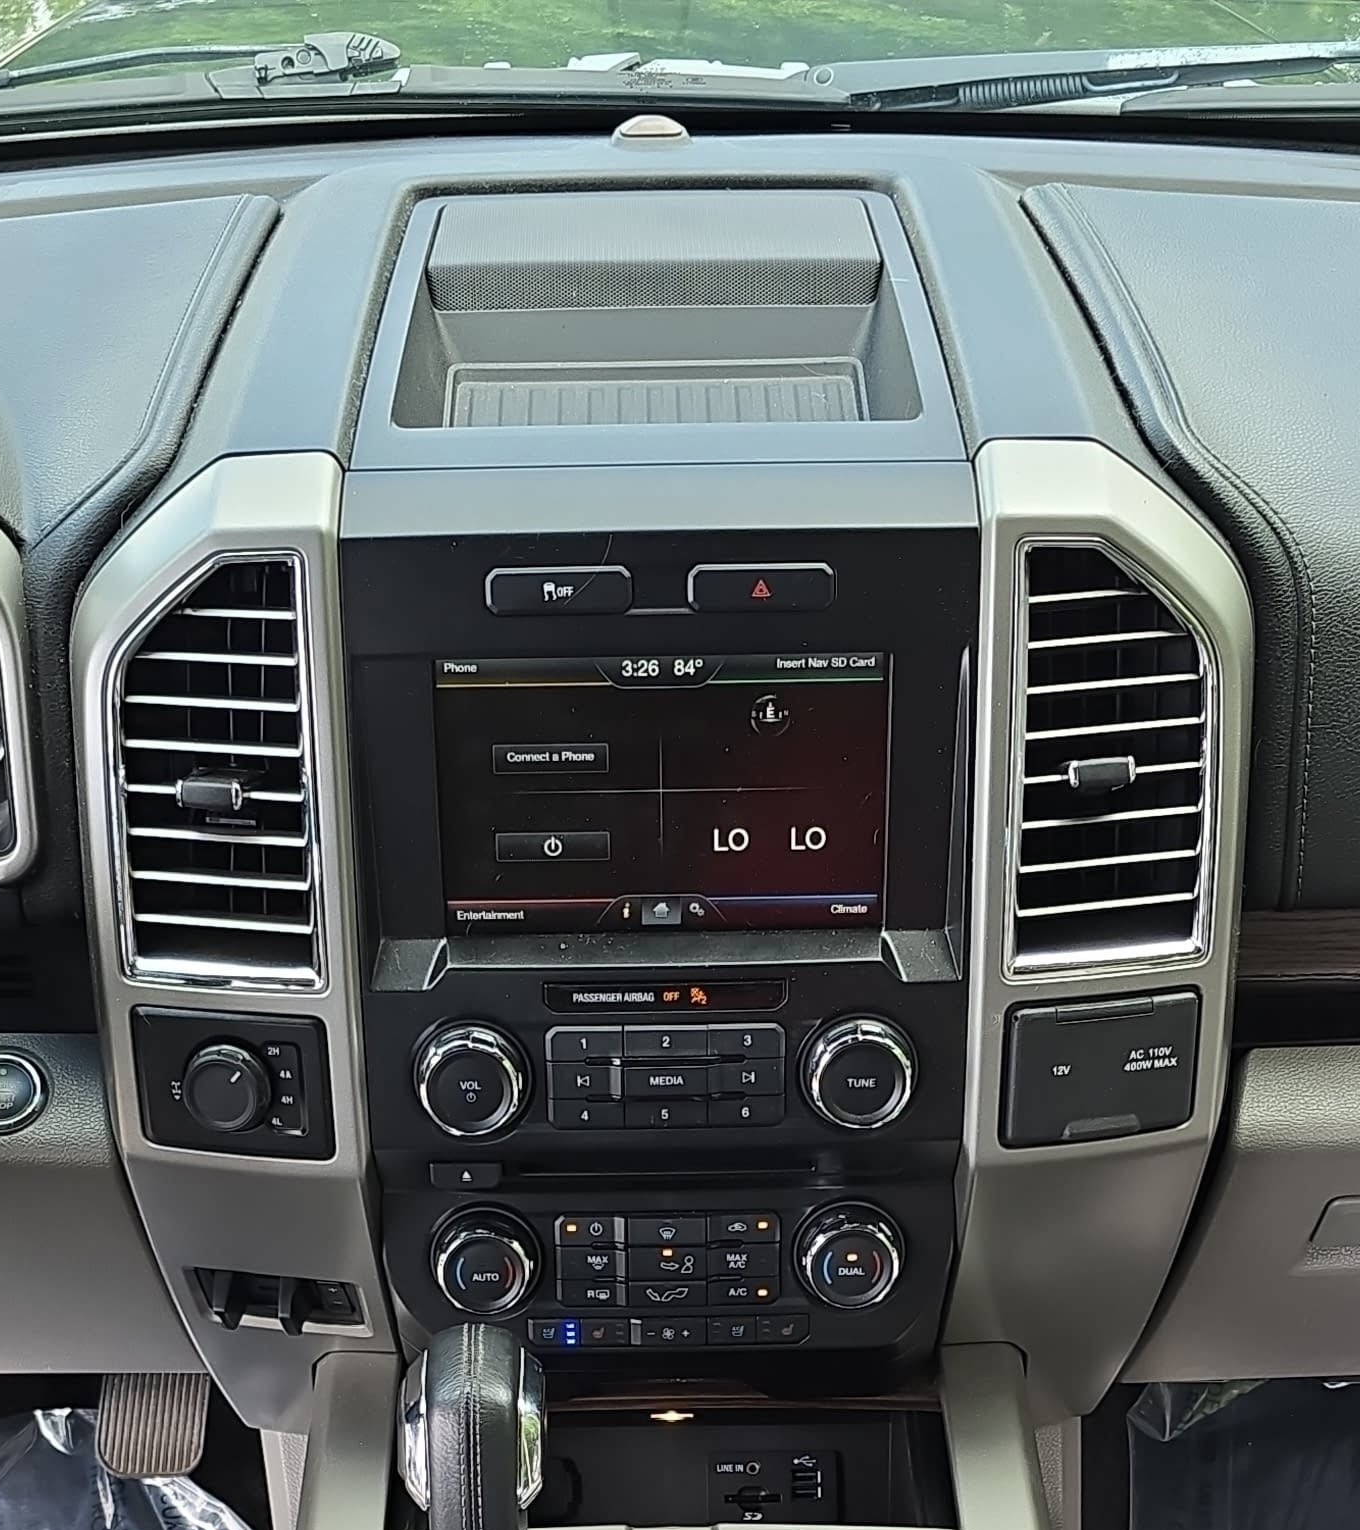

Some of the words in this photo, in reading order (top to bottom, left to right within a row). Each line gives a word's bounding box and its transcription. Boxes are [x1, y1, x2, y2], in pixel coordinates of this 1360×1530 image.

[556, 583, 575, 599] OFF
[621, 658, 660, 678] 3:26
[776, 657, 806, 669] Insert
[808, 656, 830, 669] Nav
[830, 656, 848, 668] SD
[849, 655, 876, 668] Card
[442, 663, 478, 676] Phone
[506, 749, 551, 763] Connect
[561, 749, 596, 763] Phone
[713, 827, 750, 853] LO
[790, 826, 828, 852] LO
[456, 907, 525, 923] Entertainment
[830, 903, 869, 917] Climate
[572, 990, 622, 1003] PASSENGER
[623, 990, 655, 1003] AIRBAG
[662, 990, 681, 1002] OFF
[579, 1036, 588, 1050] 1
[660, 1035, 671, 1049] 2
[742, 1034, 753, 1048] 3
[267, 1046, 280, 1056] 2H
[1129, 1050, 1145, 1060] AC
[1148, 1046, 1173, 1058] 110V
[1051, 1064, 1072, 1076] 12V
[1122, 1060, 1154, 1073] 400W
[1153, 1056, 1179, 1069] MAX
[279, 1070, 293, 1080] 4A
[648, 1074, 685, 1088] MEDIA
[458, 1079, 482, 1092] VOL
[846, 1076, 878, 1090] TUNE
[280, 1095, 294, 1105] 4H
[580, 1108, 590, 1122] 4
[659, 1107, 670, 1122] 5
[741, 1105, 751, 1120] 6
[270, 1116, 283, 1126] 4L
[587, 1254, 610, 1265] MAX
[726, 1253, 749, 1263] MAX
[728, 1260, 747, 1270] A/C
[471, 1270, 501, 1284] AUTO
[837, 1264, 866, 1278] DUAL
[728, 1286, 749, 1298] A/C
[716, 1463, 733, 1473] LINE
[734, 1463, 744, 1473] IN
